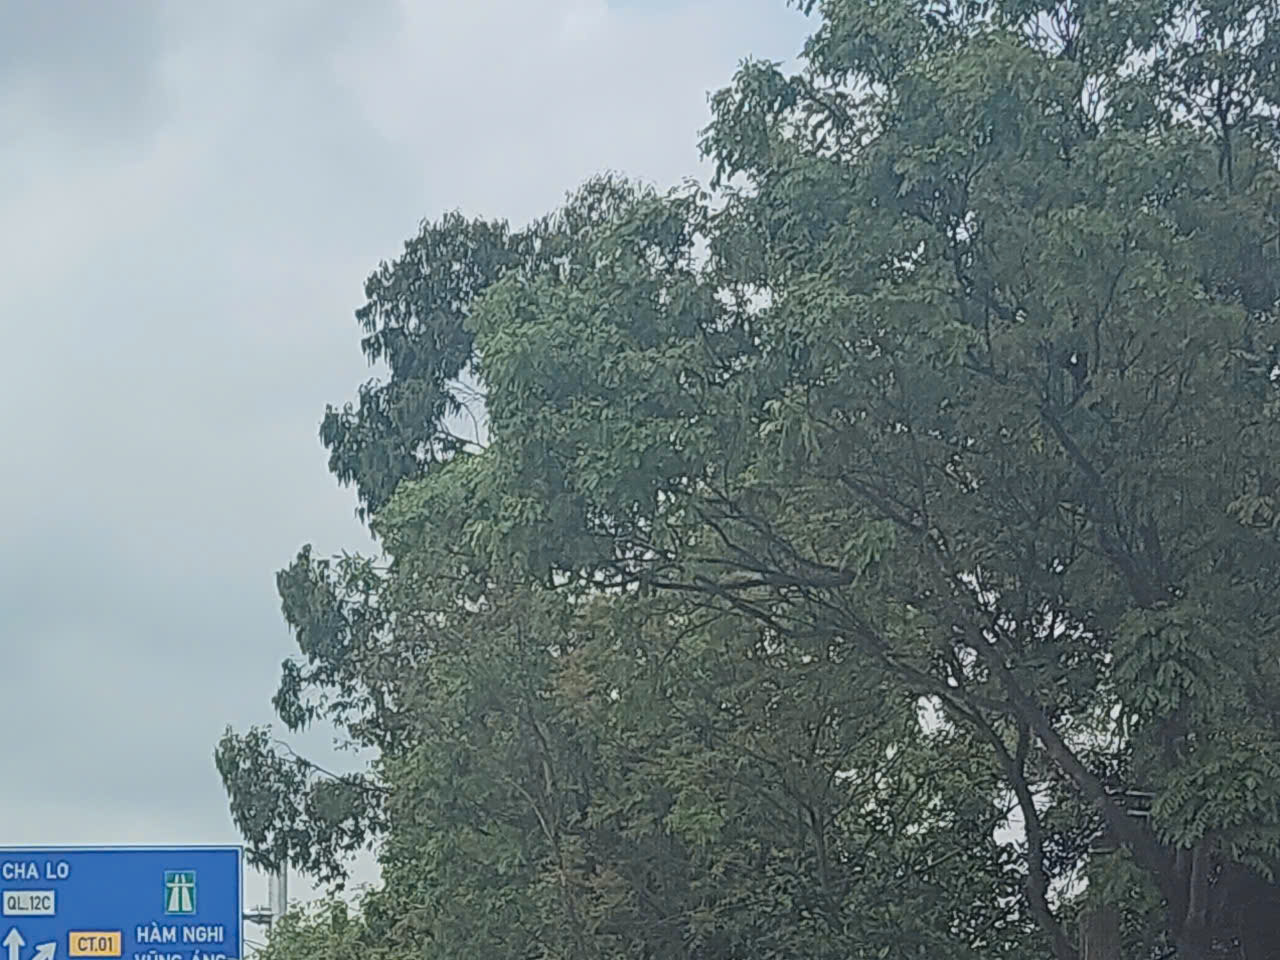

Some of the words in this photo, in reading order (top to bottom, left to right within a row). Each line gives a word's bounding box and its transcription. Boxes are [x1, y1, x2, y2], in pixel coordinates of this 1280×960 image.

[2, 862, 39, 879] CHA
[46, 862, 69, 879] LO
[7, 895, 51, 911] QL.12C
[136, 921, 177, 943] HÀM
[183, 926, 224, 943] NGHI
[77, 936, 113, 952] CT.01
